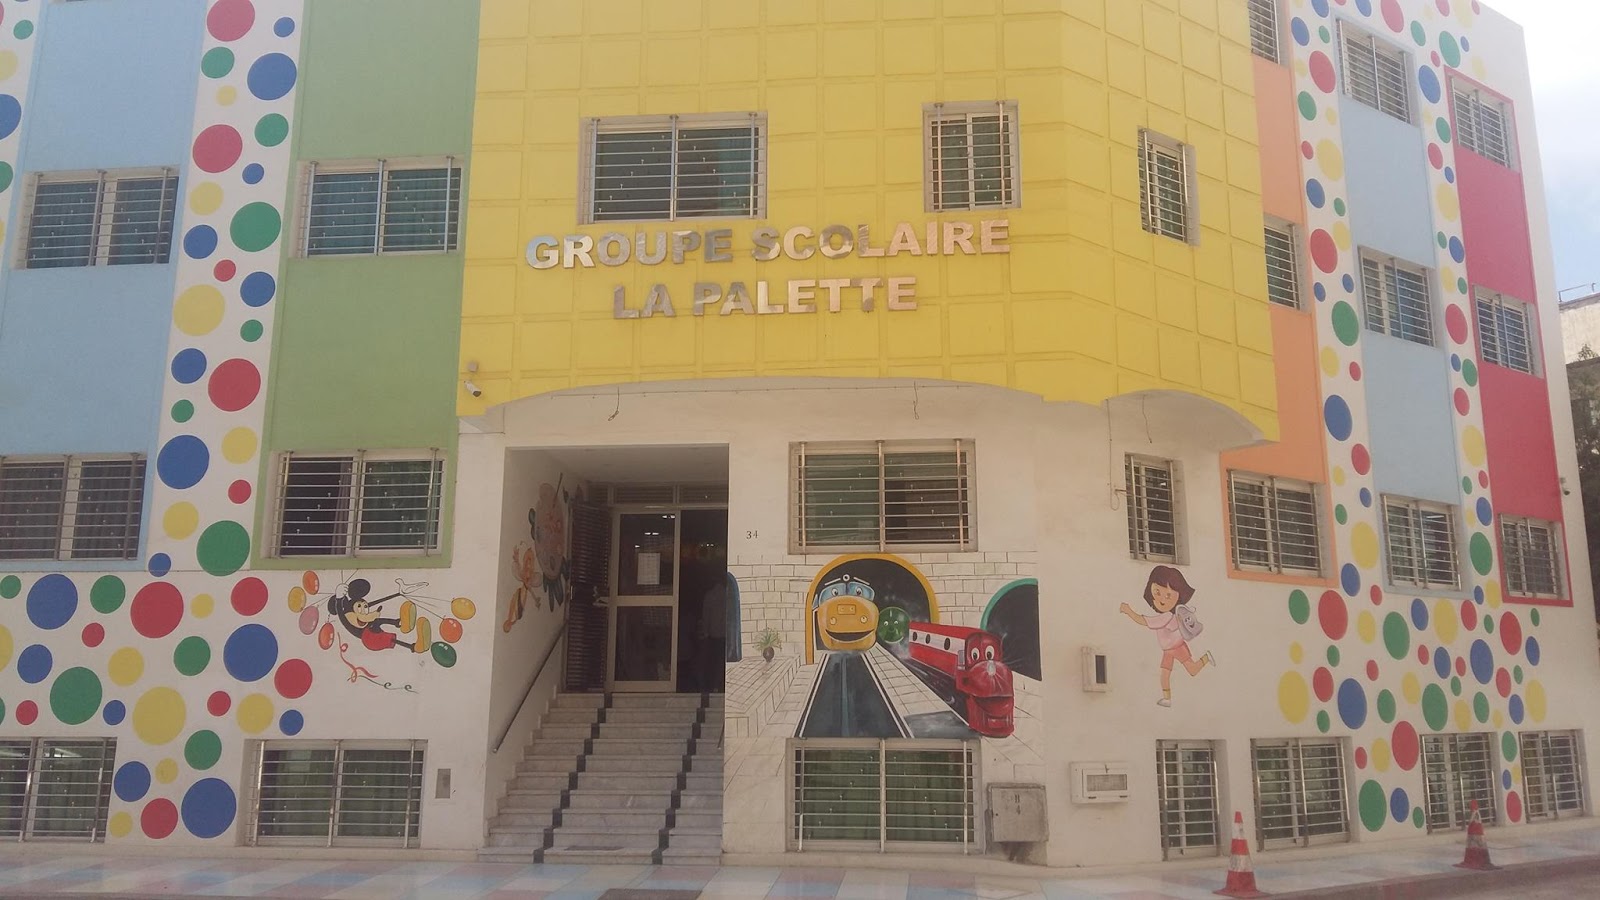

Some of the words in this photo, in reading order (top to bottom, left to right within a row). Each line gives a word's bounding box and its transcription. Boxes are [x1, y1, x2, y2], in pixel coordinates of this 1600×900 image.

[525, 229, 733, 270] GROUPE
[752, 219, 1010, 261] SCOLAIRE
[613, 283, 676, 319] LA
[692, 276, 917, 317] PALETTE
[746, 530, 758, 540] 34
